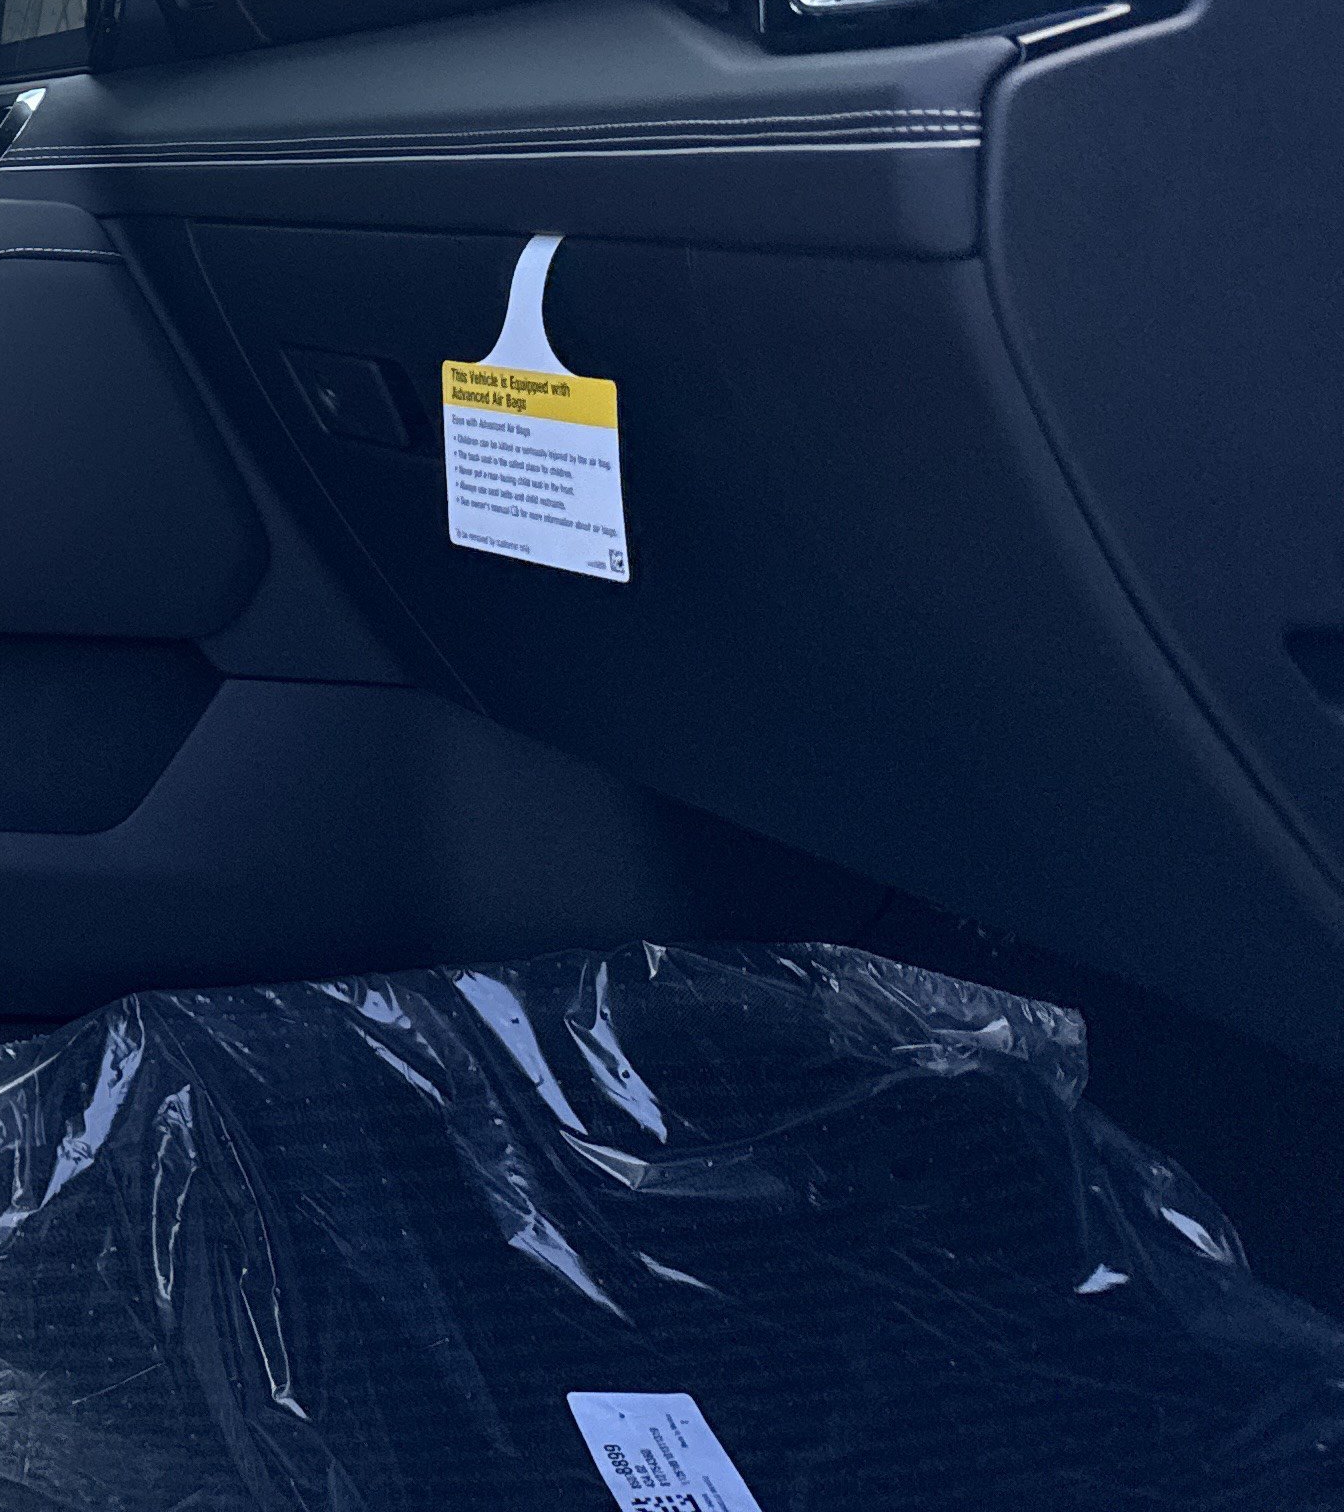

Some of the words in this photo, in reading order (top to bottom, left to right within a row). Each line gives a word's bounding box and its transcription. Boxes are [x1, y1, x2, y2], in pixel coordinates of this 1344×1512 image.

[451, 367, 468, 383] This
[469, 371, 498, 387] Vehicle
[500, 374, 508, 389] is
[509, 375, 549, 395] Equipped
[551, 382, 570, 397] with
[451, 386, 490, 405] Advanced
[492, 392, 503, 406] Air
[506, 393, 527, 412] Bags
